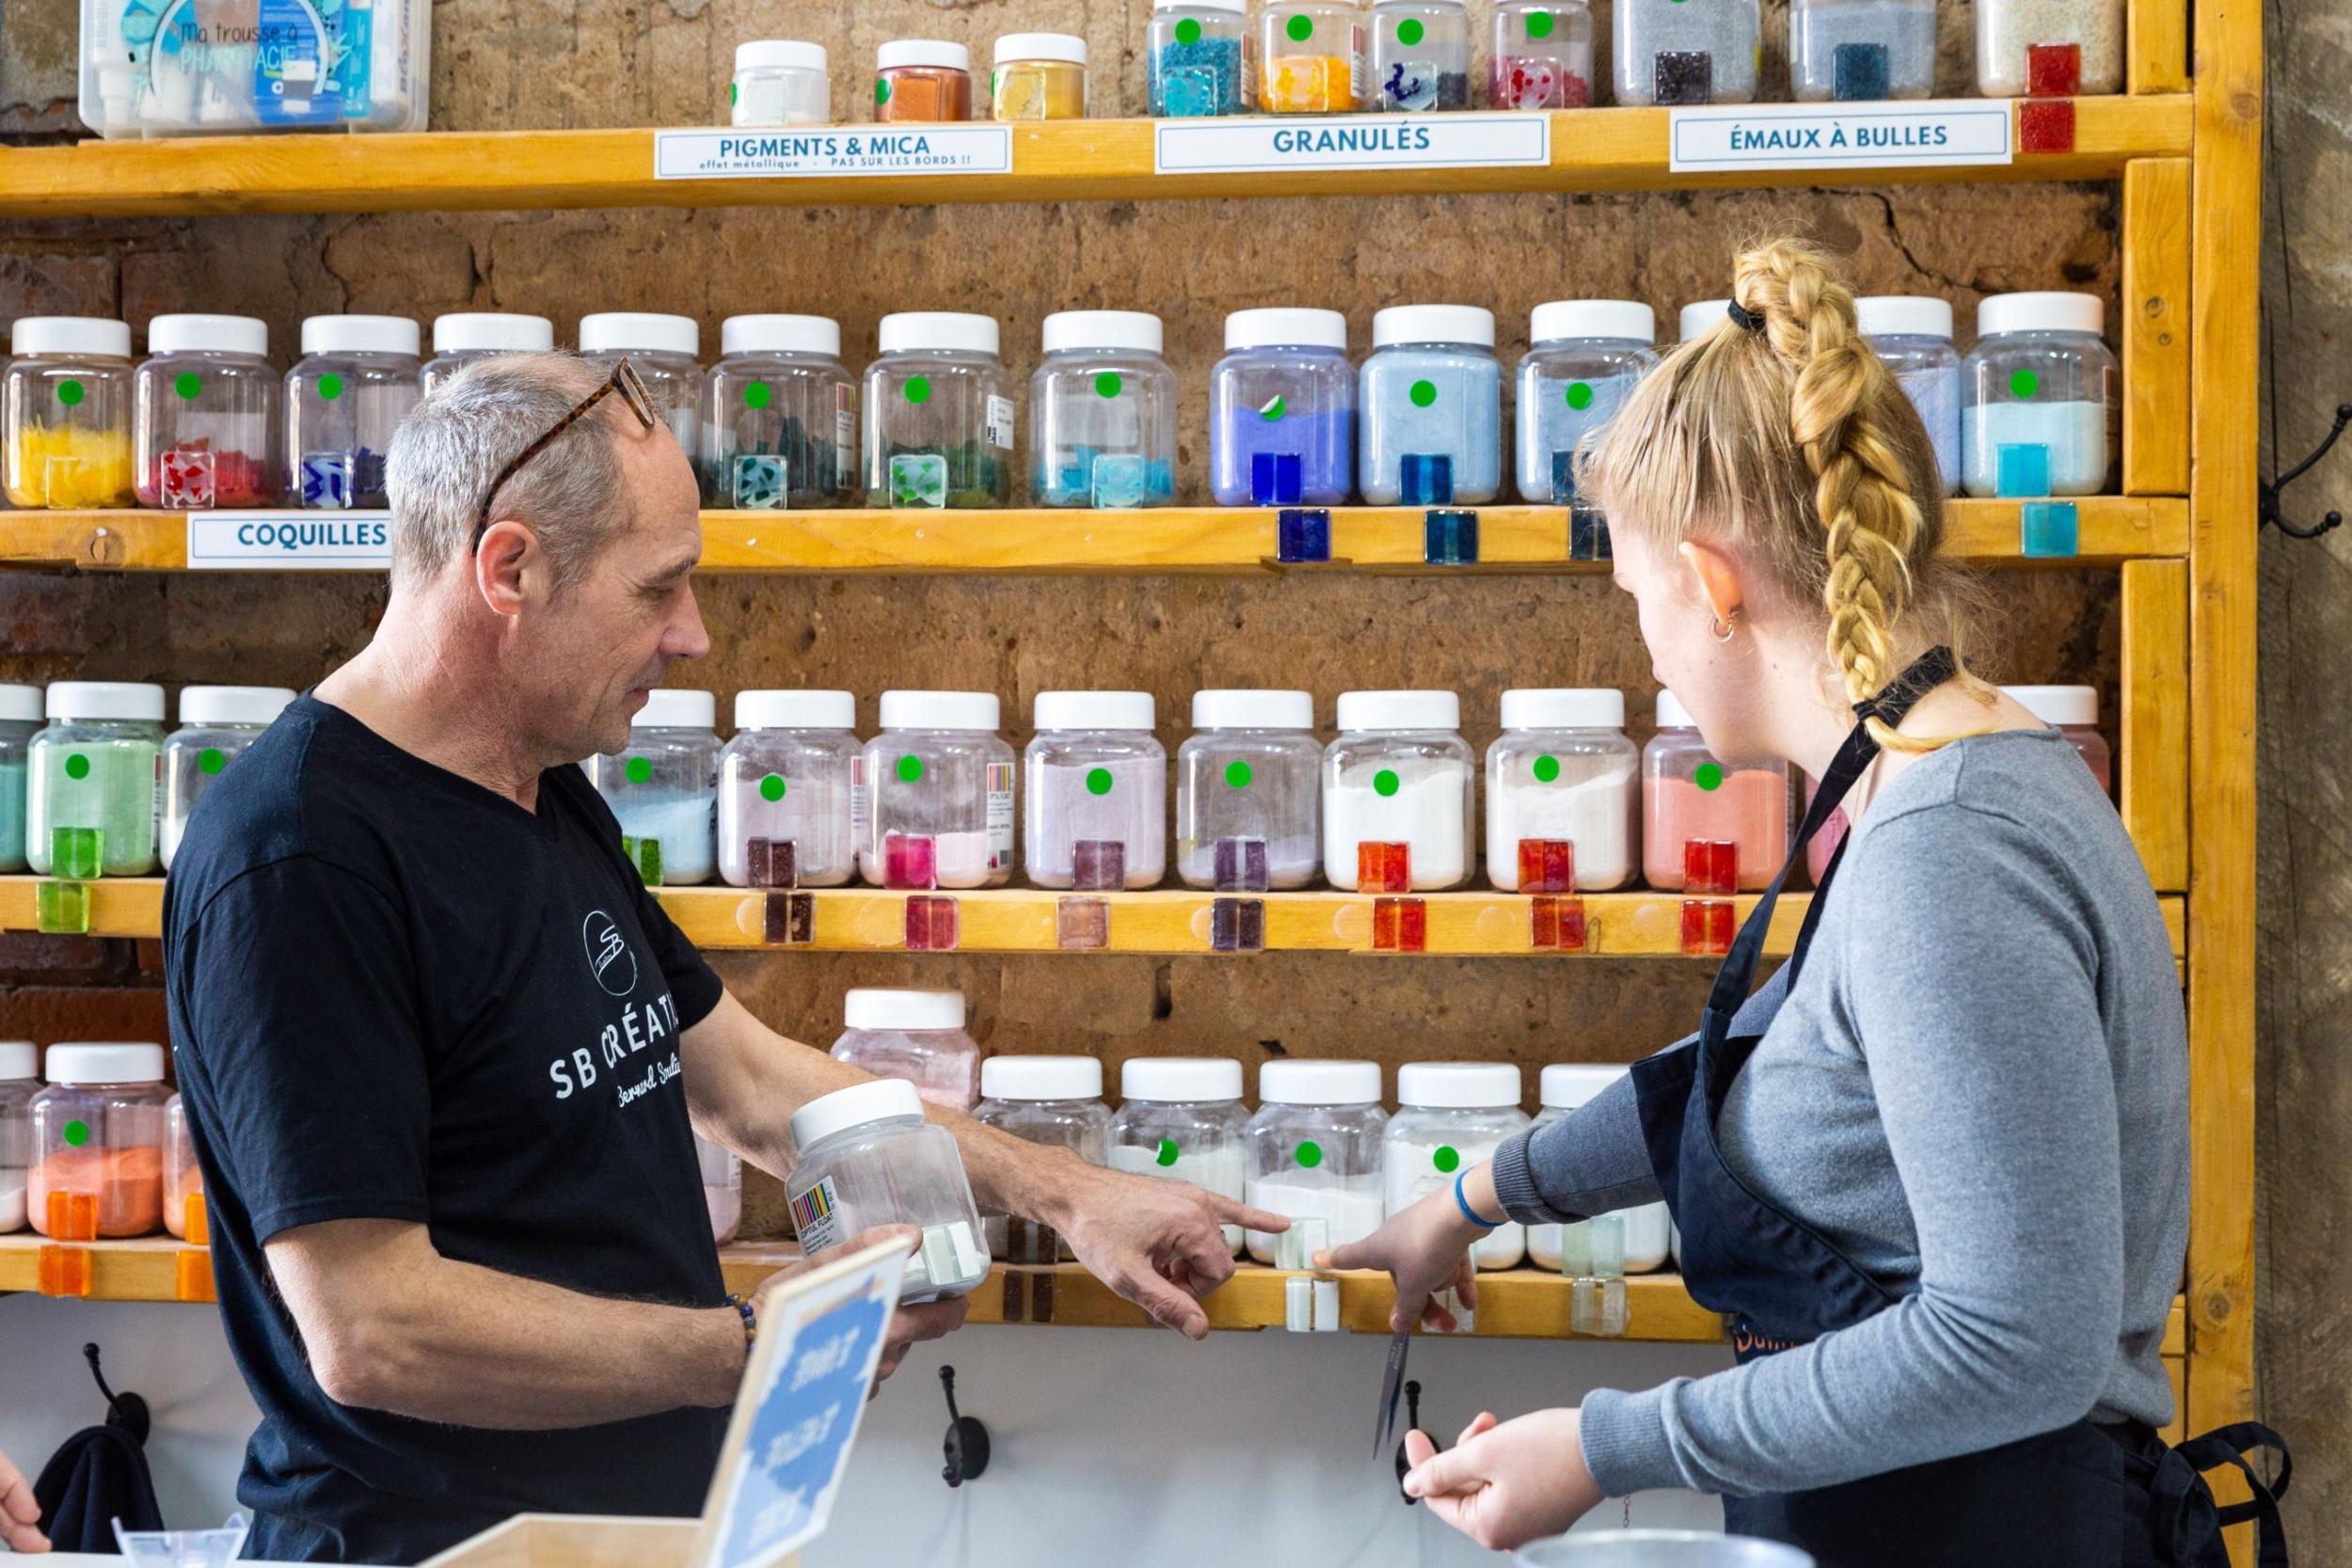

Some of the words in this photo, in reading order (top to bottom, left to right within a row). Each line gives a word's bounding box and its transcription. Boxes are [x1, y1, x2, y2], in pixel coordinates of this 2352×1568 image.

[181, 23, 208, 43] Ma
[216, 23, 281, 43] trousse
[720, 137, 836, 158] PIGMENTS
[845, 136, 863, 156] &
[870, 135, 930, 155] MICA
[1273, 119, 1431, 152] GRANULÉS
[1730, 124, 1821, 150] ÉMAUX
[1829, 121, 1848, 148] À
[1856, 125, 1948, 147] BULLES
[699, 160, 728, 169] effet
[733, 158, 801, 169] métallique
[831, 157, 855, 166] PAS
[860, 156, 884, 166] SUR
[888, 156, 911, 166] LES
[914, 155, 957, 166] BORDS
[237, 523, 387, 550] COQUILLES
[549, 1047, 596, 1100] SB
[617, 1064, 658, 1108] Bernard
